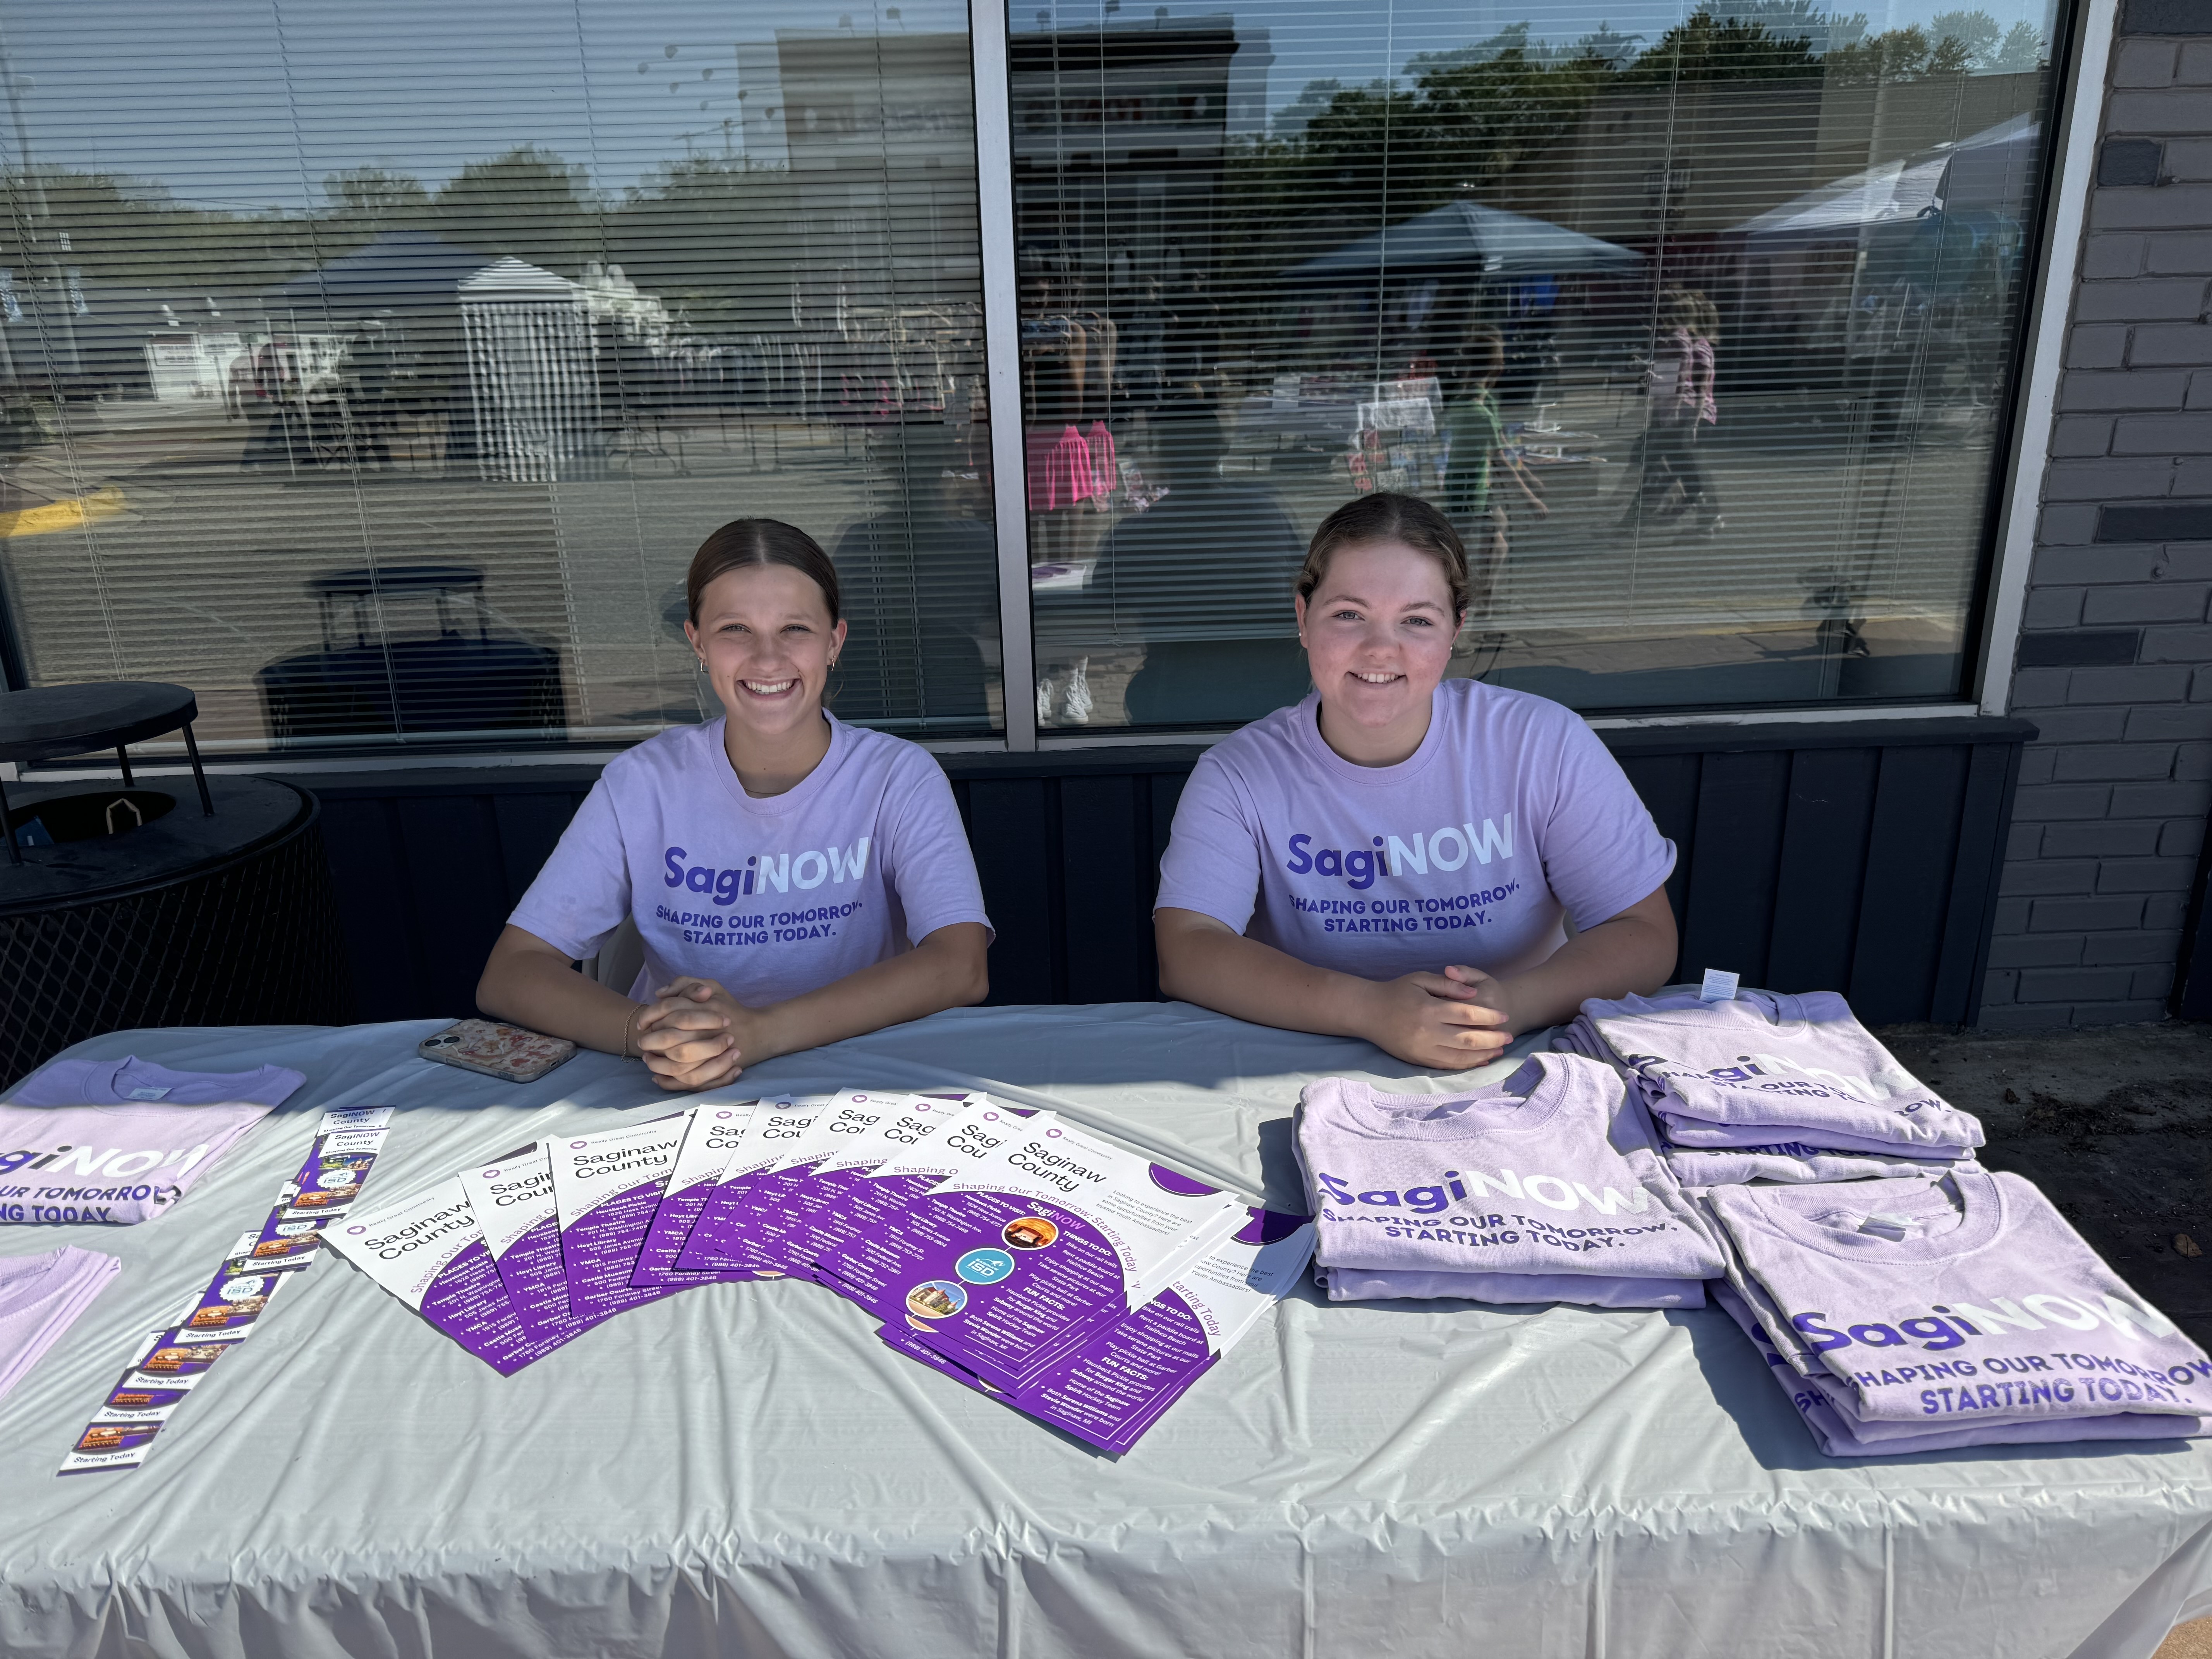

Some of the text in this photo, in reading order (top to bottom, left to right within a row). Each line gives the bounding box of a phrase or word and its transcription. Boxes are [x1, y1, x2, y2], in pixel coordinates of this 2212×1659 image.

[1286, 812, 1513, 890] SagiNOW
[664, 837, 869, 906] SagiNOW
[1289, 878, 1520, 914] SHAPING OUR TOMORROW.
[656, 905, 723, 929] SHAPING
[728, 915, 764, 929] OUR
[1324, 910, 1492, 933] STARTING TODAY.
[684, 924, 836, 946] STARTING TODAY.
[1760, 1081, 1814, 1090] OUR
[573, 1140, 677, 1166] Saginaw
[836, 1159, 888, 1168] Shaping
[1023, 1142, 1107, 1183] Saginaw
[1088, 1148, 1113, 1161] Community
[575, 1154, 668, 1178] County
[682, 1167, 724, 1185] Shapin
[894, 1166, 946, 1175] Shaping
[1008, 1154, 1080, 1192] County
[0, 1185, 31, 1198] UR
[570, 1178, 641, 1217] Shaping Our
[1113, 1190, 1133, 1201] Looking
[1141, 1203, 1169, 1216] experience
[1318, 1168, 1648, 1216] SagiNOW
[931, 1199, 966, 1218] Temple Theatre
[976, 1192, 1001, 1204] PLACES
[1009, 1205, 1026, 1216] VISIT:
[1027, 1201, 1085, 1230] SagiNOW
[1113, 1197, 1135, 1209] Saginaw
[1136, 1207, 1158, 1218] County?
[1117, 1206, 1151, 1221] opportunities
[364, 1200, 470, 1250] Saginaw
[500, 1214, 546, 1244] Shaping
[888, 1225, 904, 1236] YMCA
[945, 1220, 969, 1233] 754-7469
[946, 1213, 972, 1228] Washington
[971, 1225, 982, 1233] Ave.
[953, 1183, 1137, 1272] Shaping Our Tomorrow: Starting Today
[1096, 1203, 1170, 1235] trusted Youth Ambassadors!
[1323, 1208, 1678, 1238] SHAPING OUR TOMORROW.
[379, 1215, 475, 1260] County
[865, 1239, 900, 1259] Castle Museum
[899, 1239, 918, 1250] Fordney
[1063, 1230, 1089, 1245] THINGS
[1098, 1248, 1113, 1257] DO:
[1385, 1226, 1625, 1252] STARTING TODAY.
[866, 1256, 879, 1264] (989)
[874, 1252, 892, 1263] Federal
[891, 1260, 902, 1268] Ave.
[889, 1242, 924, 1261] (989) 753-7721
[410, 1243, 462, 1293] Shaping Our
[438, 1262, 469, 1278] PLACES
[967, 1261, 994, 1276] ISD
[1103, 1260, 1118, 1269] trails
[1023, 1287, 1066, 1310] FUN FACTS:
[1172, 1281, 1221, 1337] tarting Today
[1792, 1294, 2177, 1353] SagiNOW
[1983, 1357, 2053, 1374] OUR
[1920, 1377, 2192, 1414] STARTING TODAY.
[110, 1451, 136, 1460] Today
